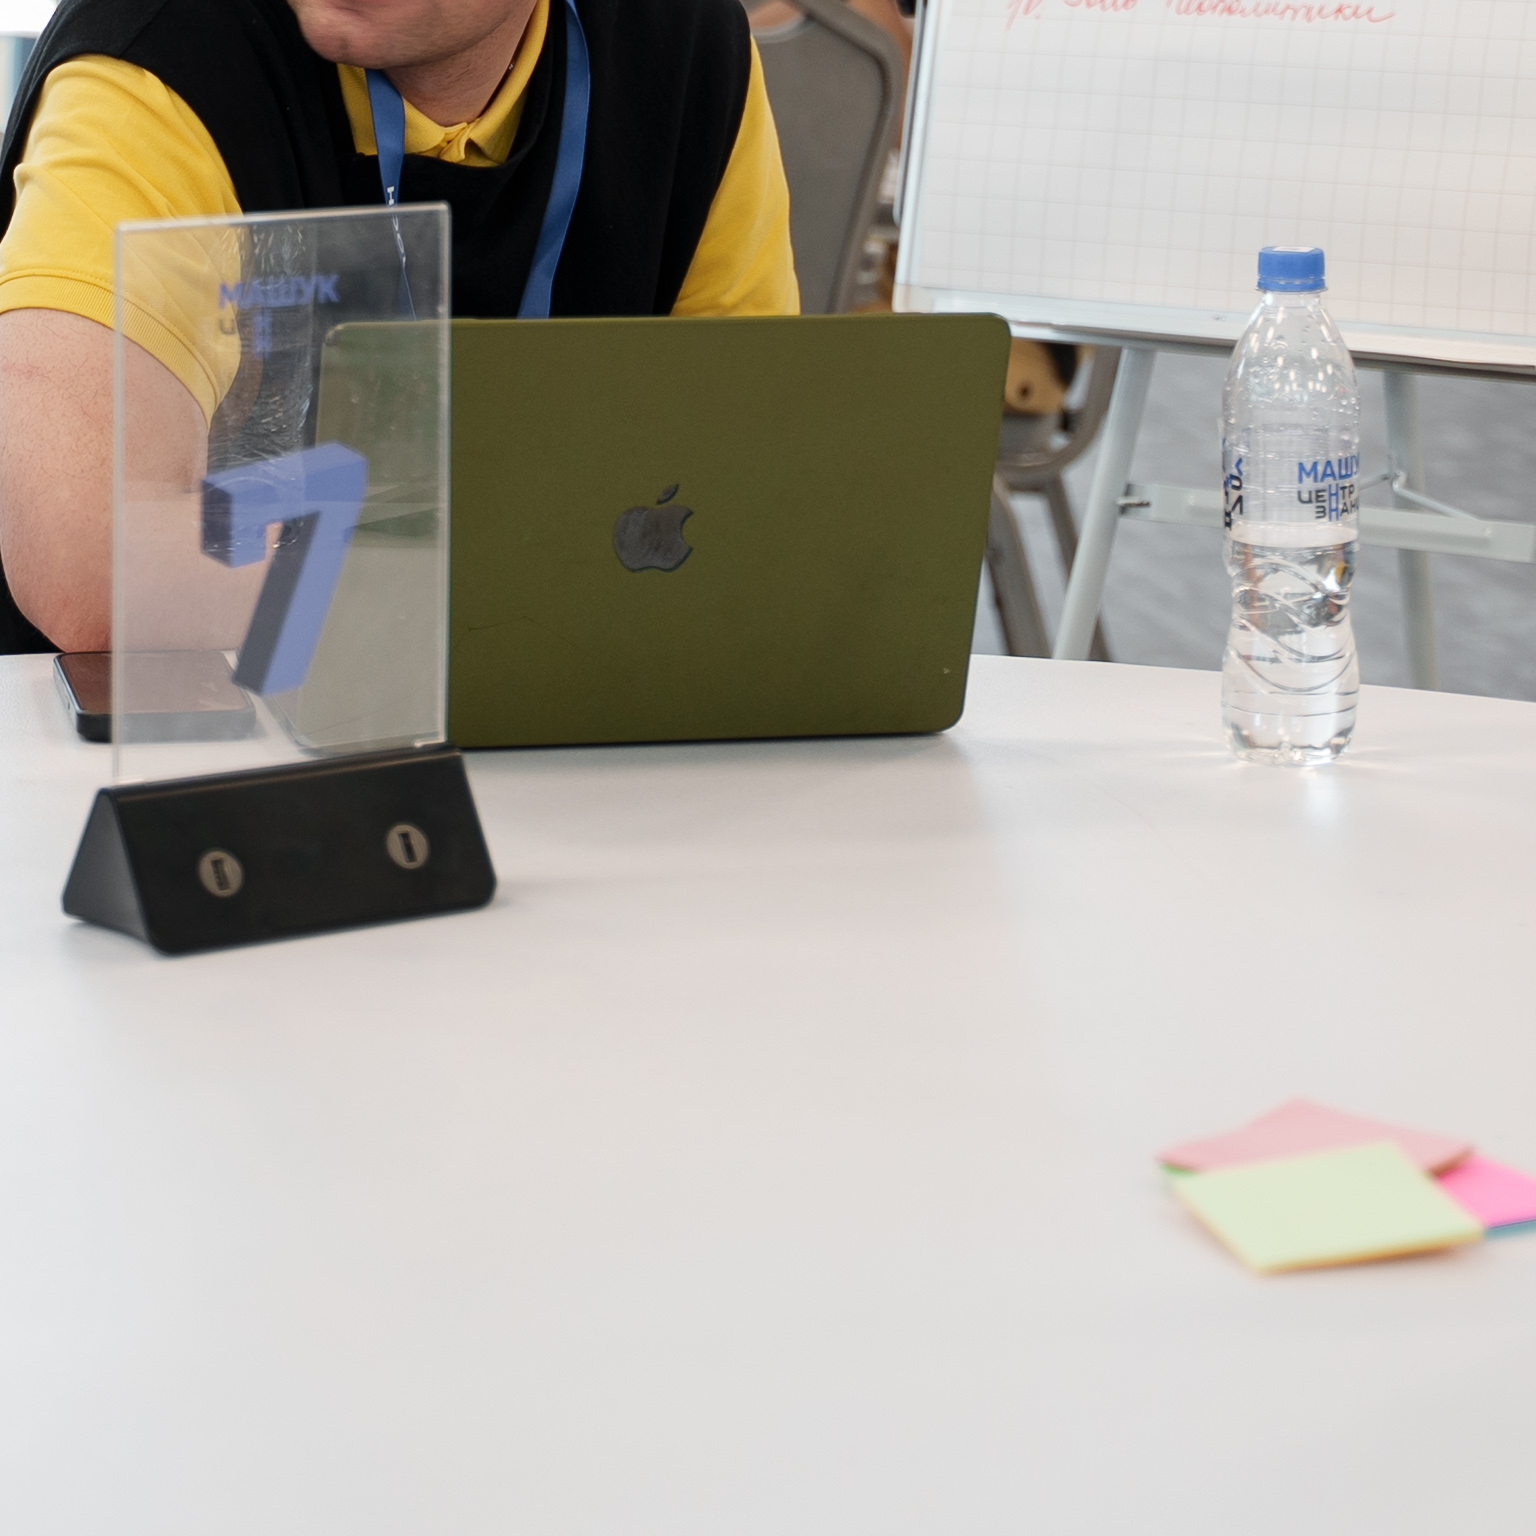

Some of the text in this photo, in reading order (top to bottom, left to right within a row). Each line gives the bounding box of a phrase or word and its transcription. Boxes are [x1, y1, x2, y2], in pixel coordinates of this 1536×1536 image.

[219, 274, 340, 310] МАШУК
[1298, 453, 1359, 484] МАШУ
[201, 440, 368, 696] 7
